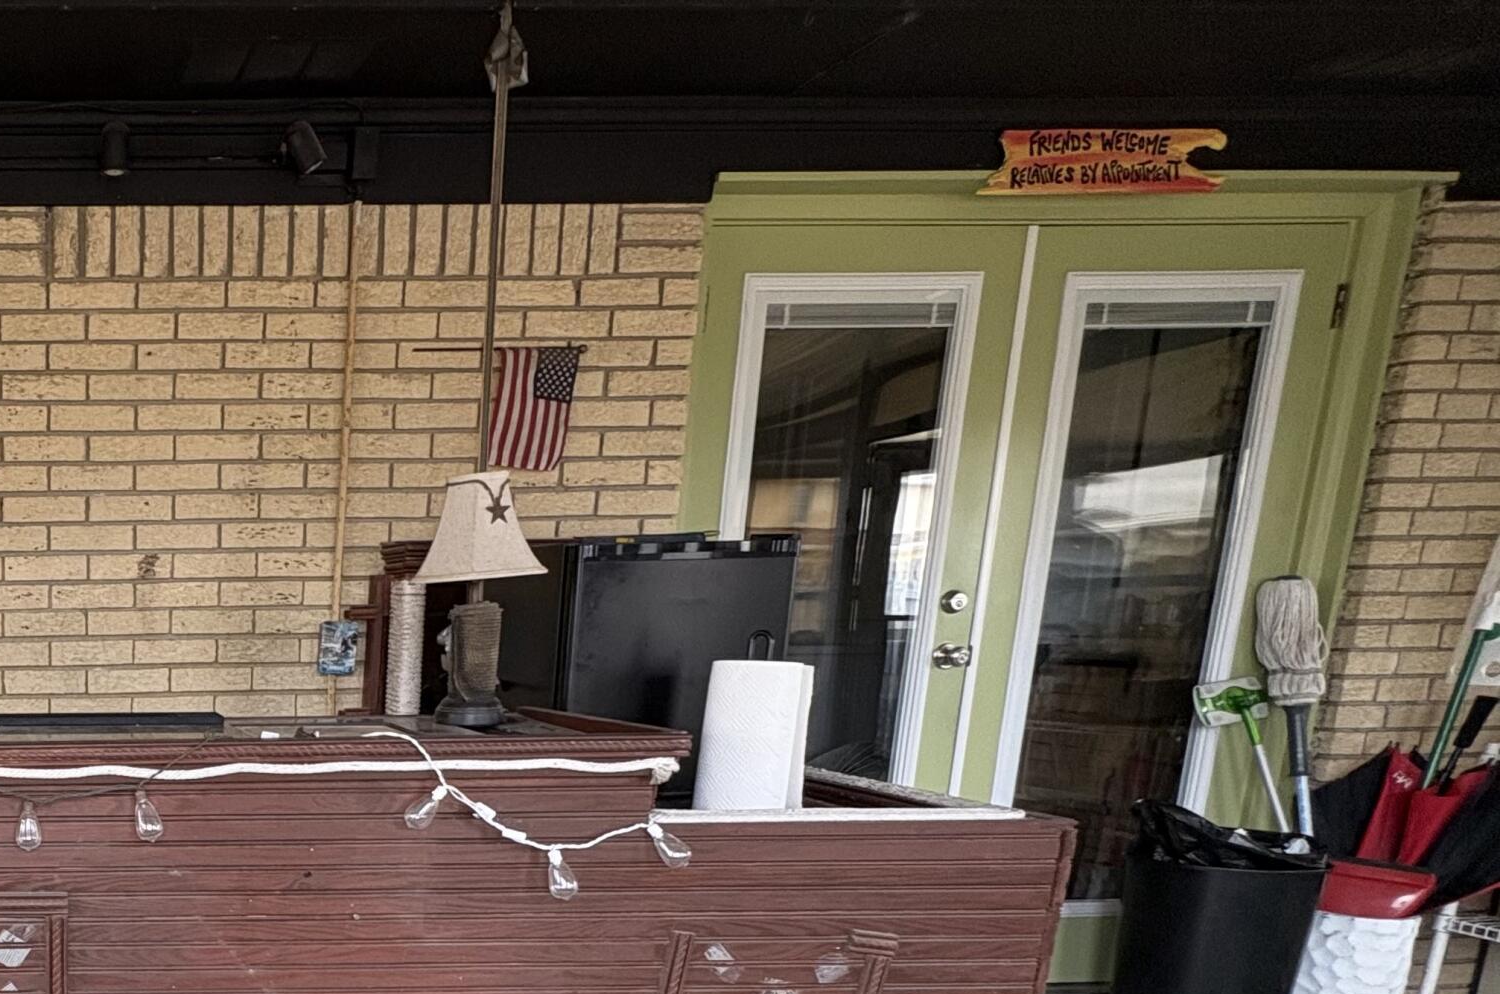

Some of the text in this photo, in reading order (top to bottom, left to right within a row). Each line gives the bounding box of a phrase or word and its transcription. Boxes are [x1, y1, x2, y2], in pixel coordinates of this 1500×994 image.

[1029, 131, 1171, 156] FRIENDS WELCOME
[1010, 160, 1182, 189] RELATIVES BY APPOINTMENT
